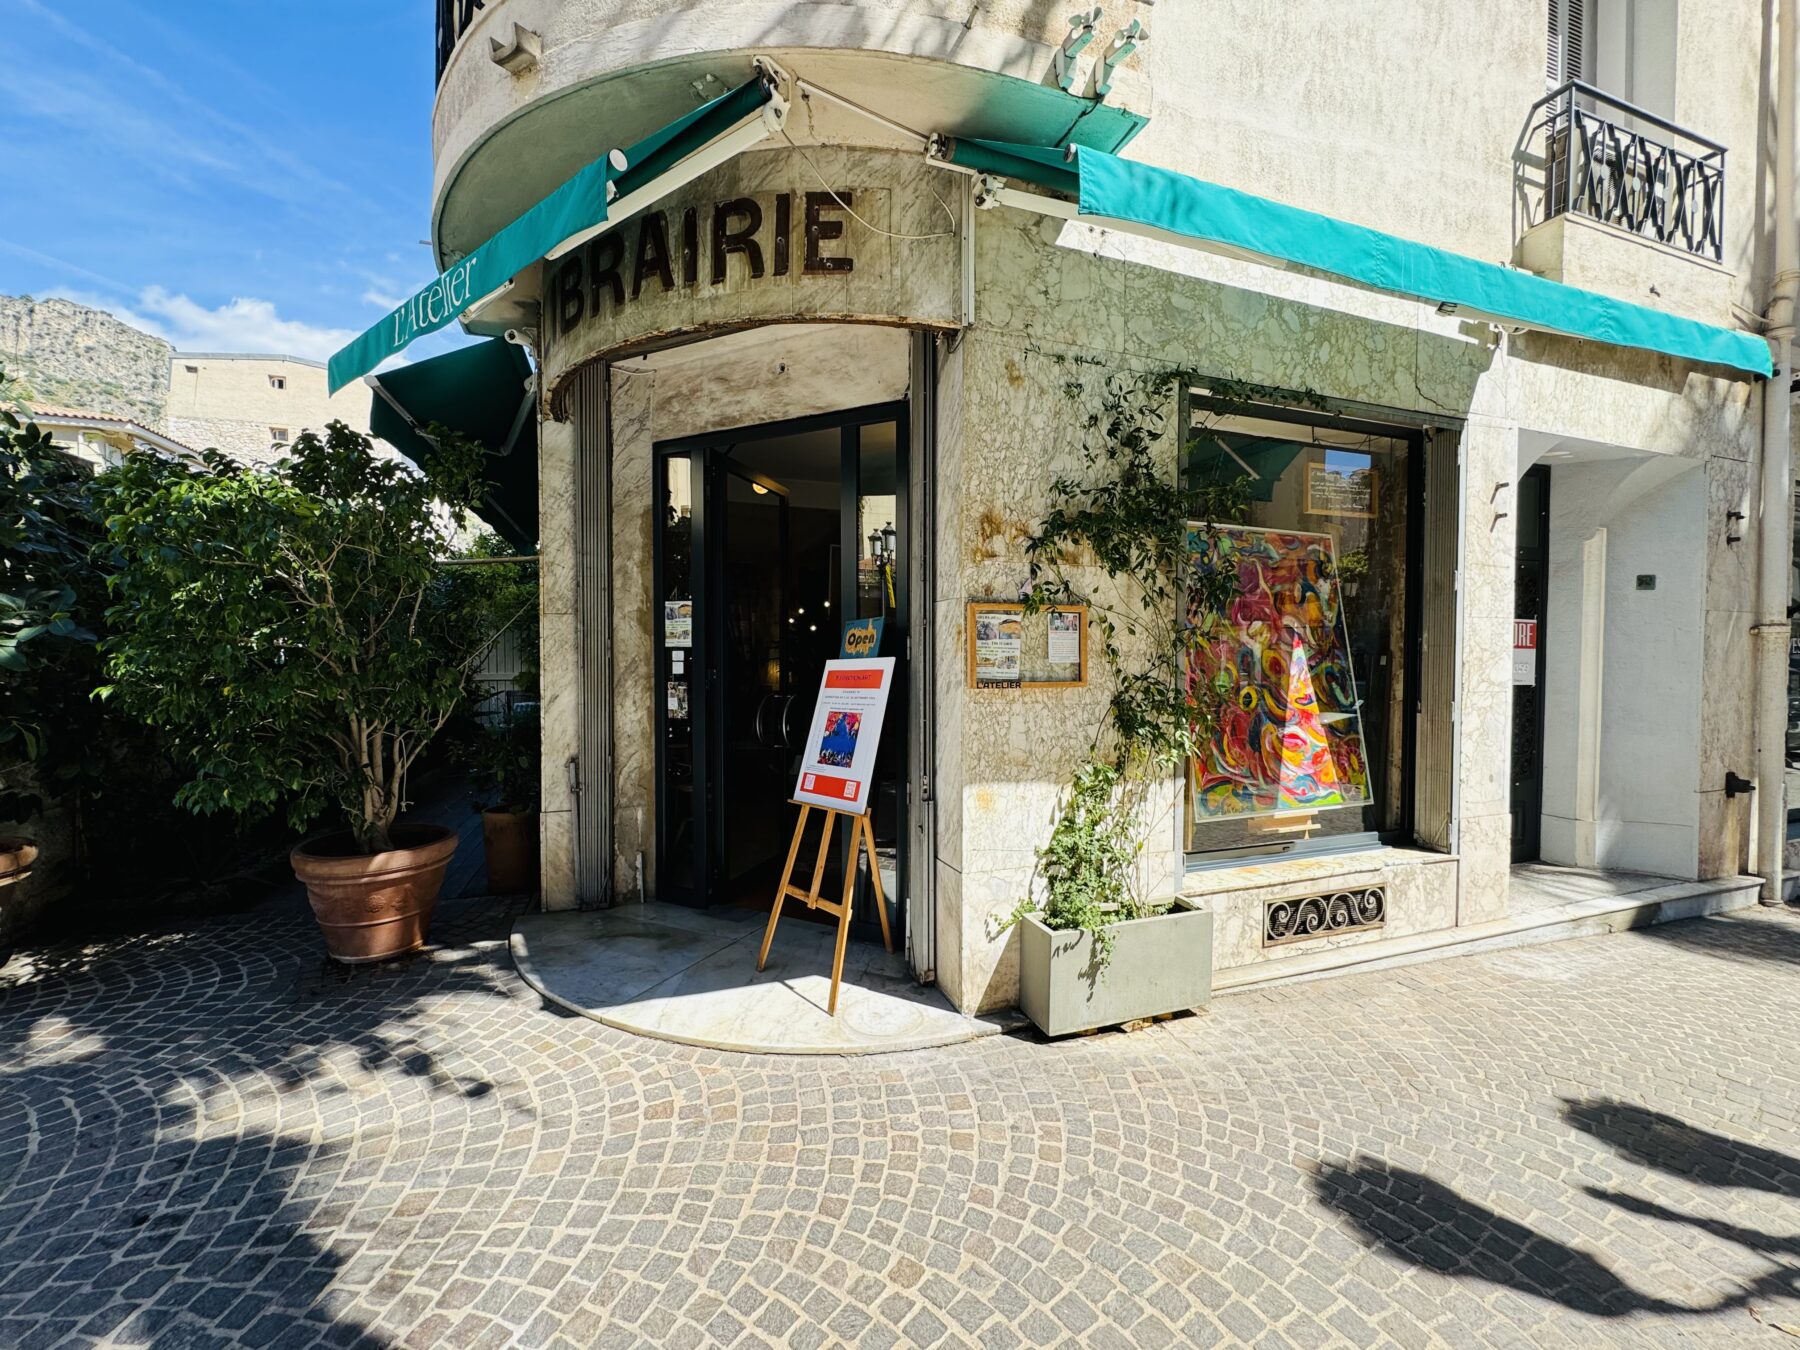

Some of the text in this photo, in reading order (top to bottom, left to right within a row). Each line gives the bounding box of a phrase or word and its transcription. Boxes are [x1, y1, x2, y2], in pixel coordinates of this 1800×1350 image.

[393, 257, 477, 347] L'Atelier
[847, 632, 875, 648] Open
[976, 681, 1022, 689] L'ATELIER
